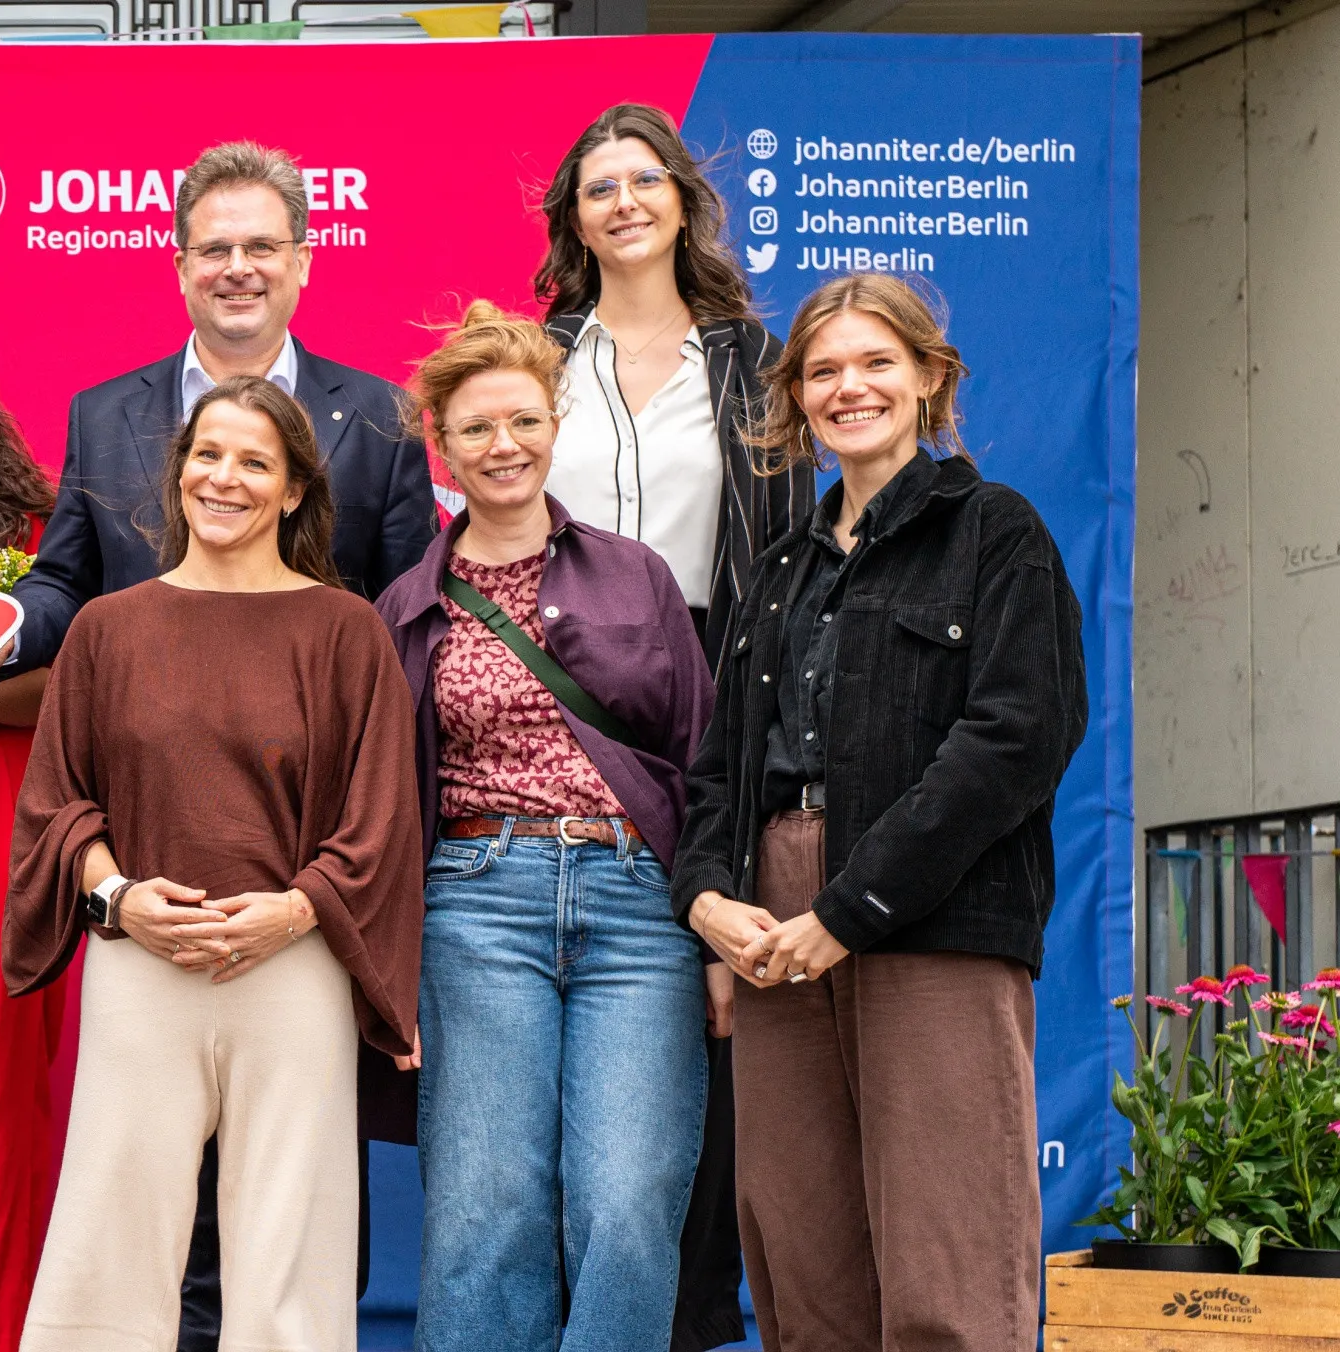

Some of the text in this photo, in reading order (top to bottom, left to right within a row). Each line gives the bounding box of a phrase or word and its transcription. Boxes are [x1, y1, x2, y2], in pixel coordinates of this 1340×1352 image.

[793, 136, 1076, 165] johanniter.de/berlin
[29, 168, 369, 213] JOHAER
[795, 173, 1028, 199] JohanniterBerlin
[796, 209, 1029, 236] JohanniterBerlin
[27, 222, 366, 255] Regionalv erlin
[796, 247, 934, 272] JUHBerlin
